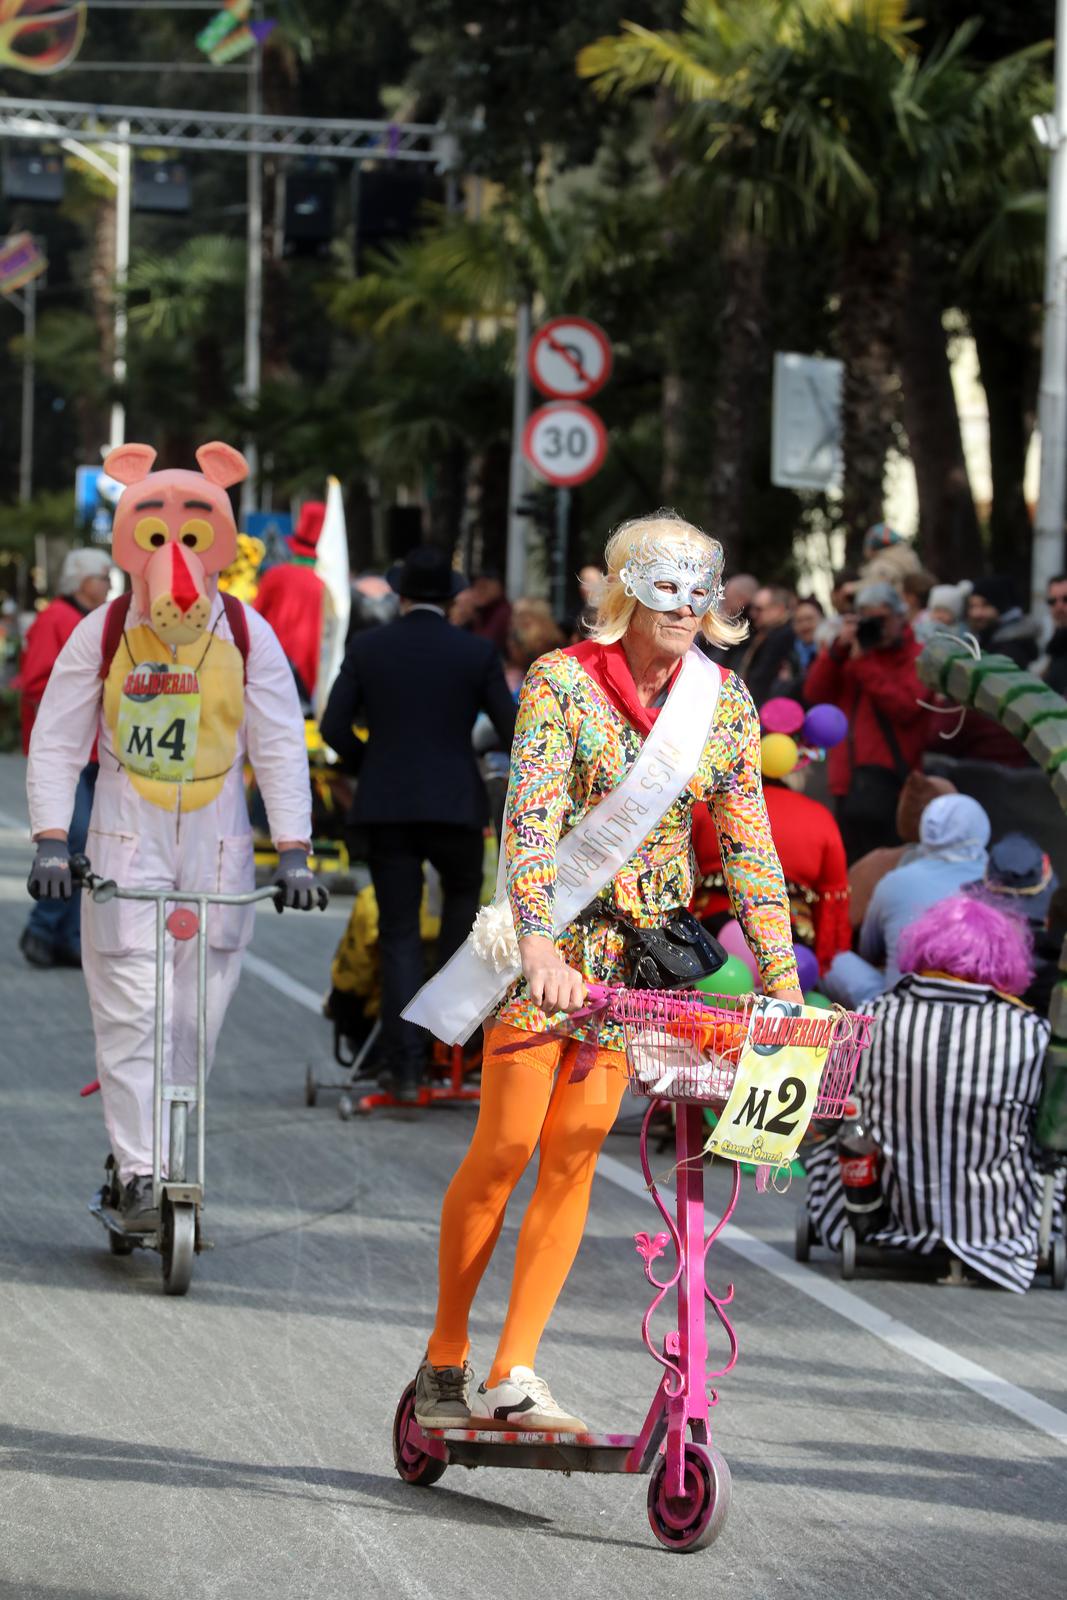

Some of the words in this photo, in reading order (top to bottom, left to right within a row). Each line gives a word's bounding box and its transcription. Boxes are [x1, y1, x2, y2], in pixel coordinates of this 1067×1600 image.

[543, 426, 588, 459] 30
[127, 717, 187, 762] M4
[640, 739, 682, 794] MISS
[751, 1015, 833, 1049] BALINJERADA
[732, 1076, 807, 1136] M2
